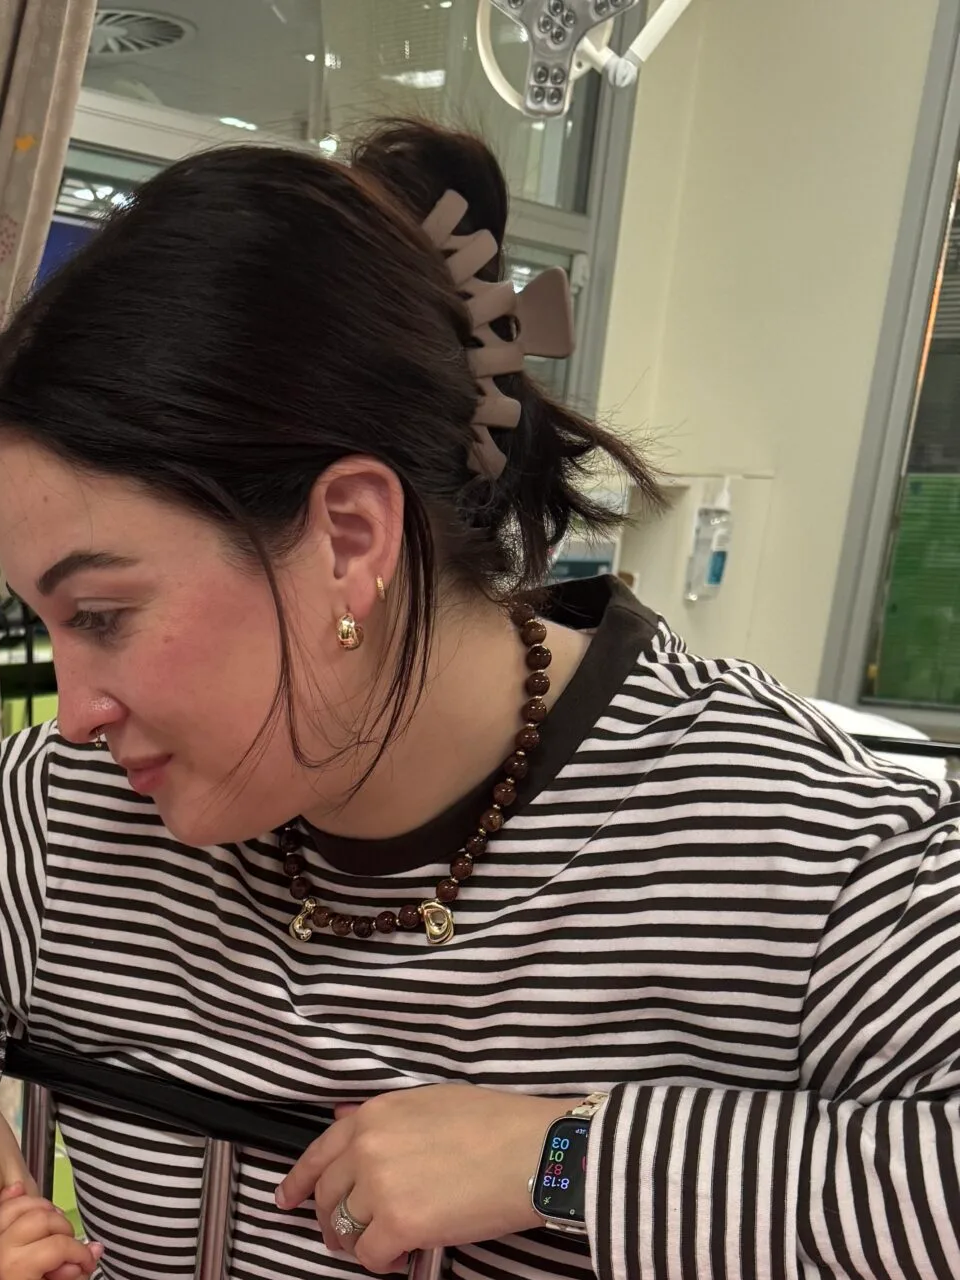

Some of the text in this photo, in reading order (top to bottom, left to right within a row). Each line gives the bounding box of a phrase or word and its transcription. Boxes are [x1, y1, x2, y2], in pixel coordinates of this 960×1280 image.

[551, 1136, 570, 1150] 03
[549, 1149, 565, 1162] 01
[545, 1163, 564, 1176] 87
[543, 1175, 570, 1190] 8:13
